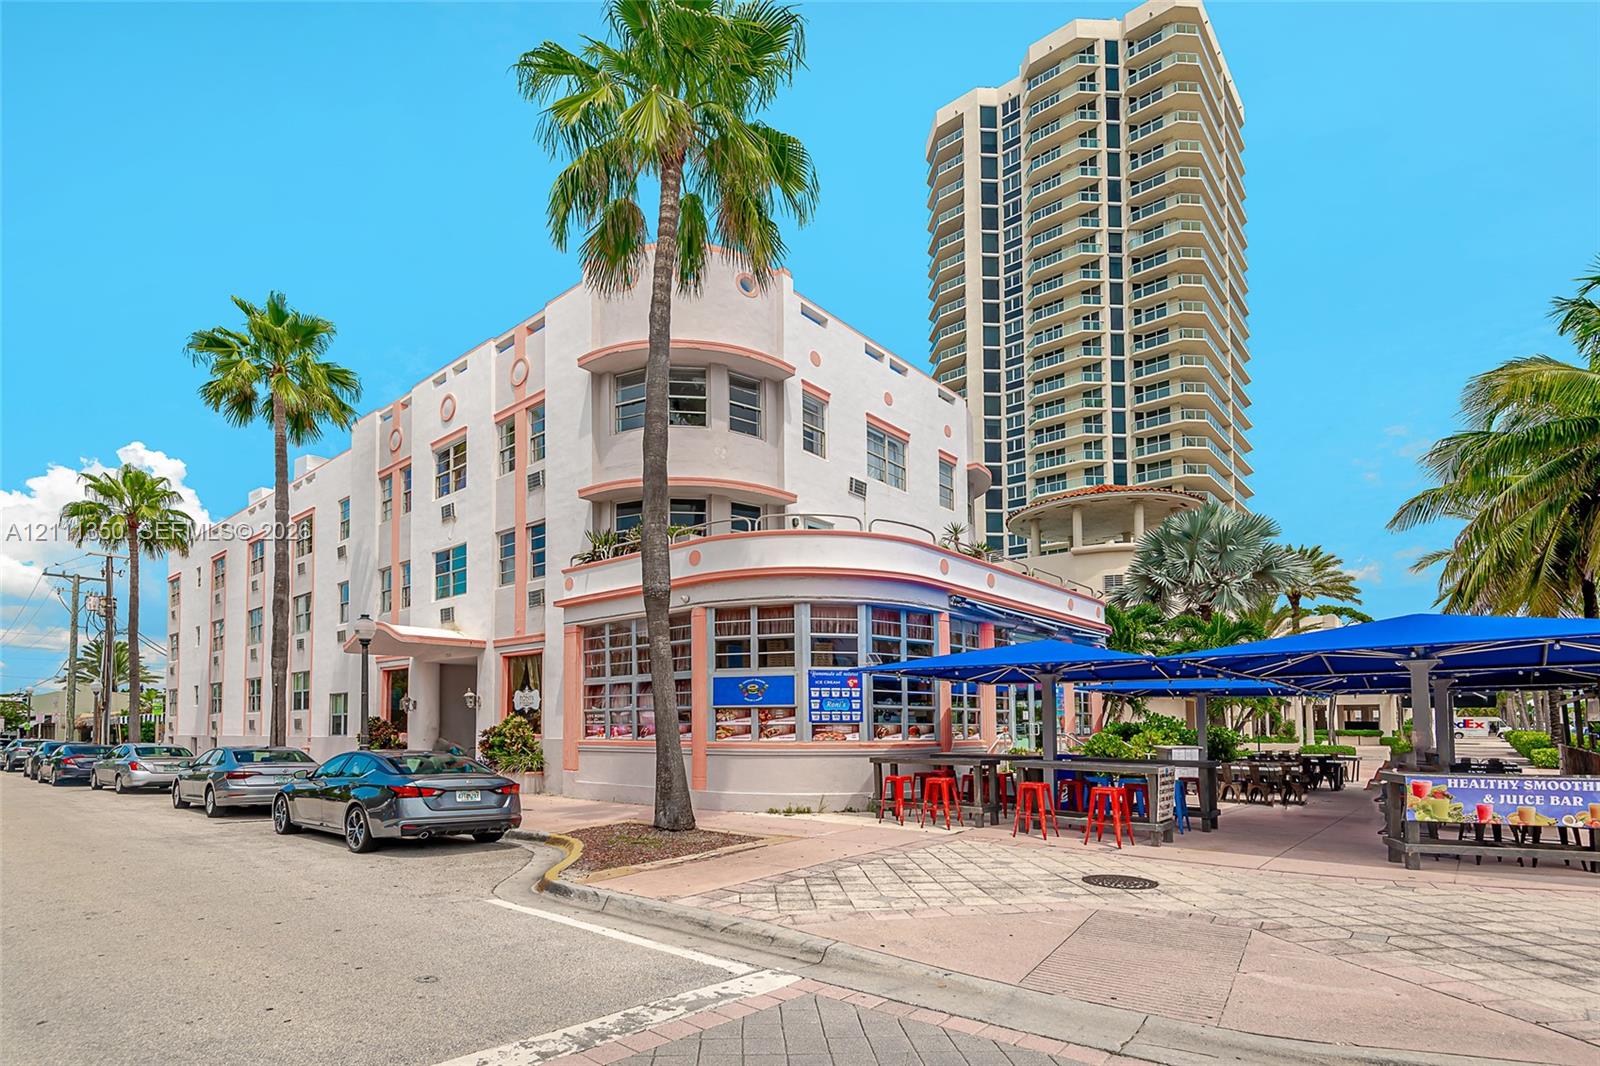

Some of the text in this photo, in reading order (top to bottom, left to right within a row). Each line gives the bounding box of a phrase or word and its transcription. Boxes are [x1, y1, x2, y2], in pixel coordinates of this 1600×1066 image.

[1454, 719, 1485, 729] dEx
[1447, 778, 1520, 791] HEALTHY
[1483, 794, 1584, 807] & JUICE BAR
